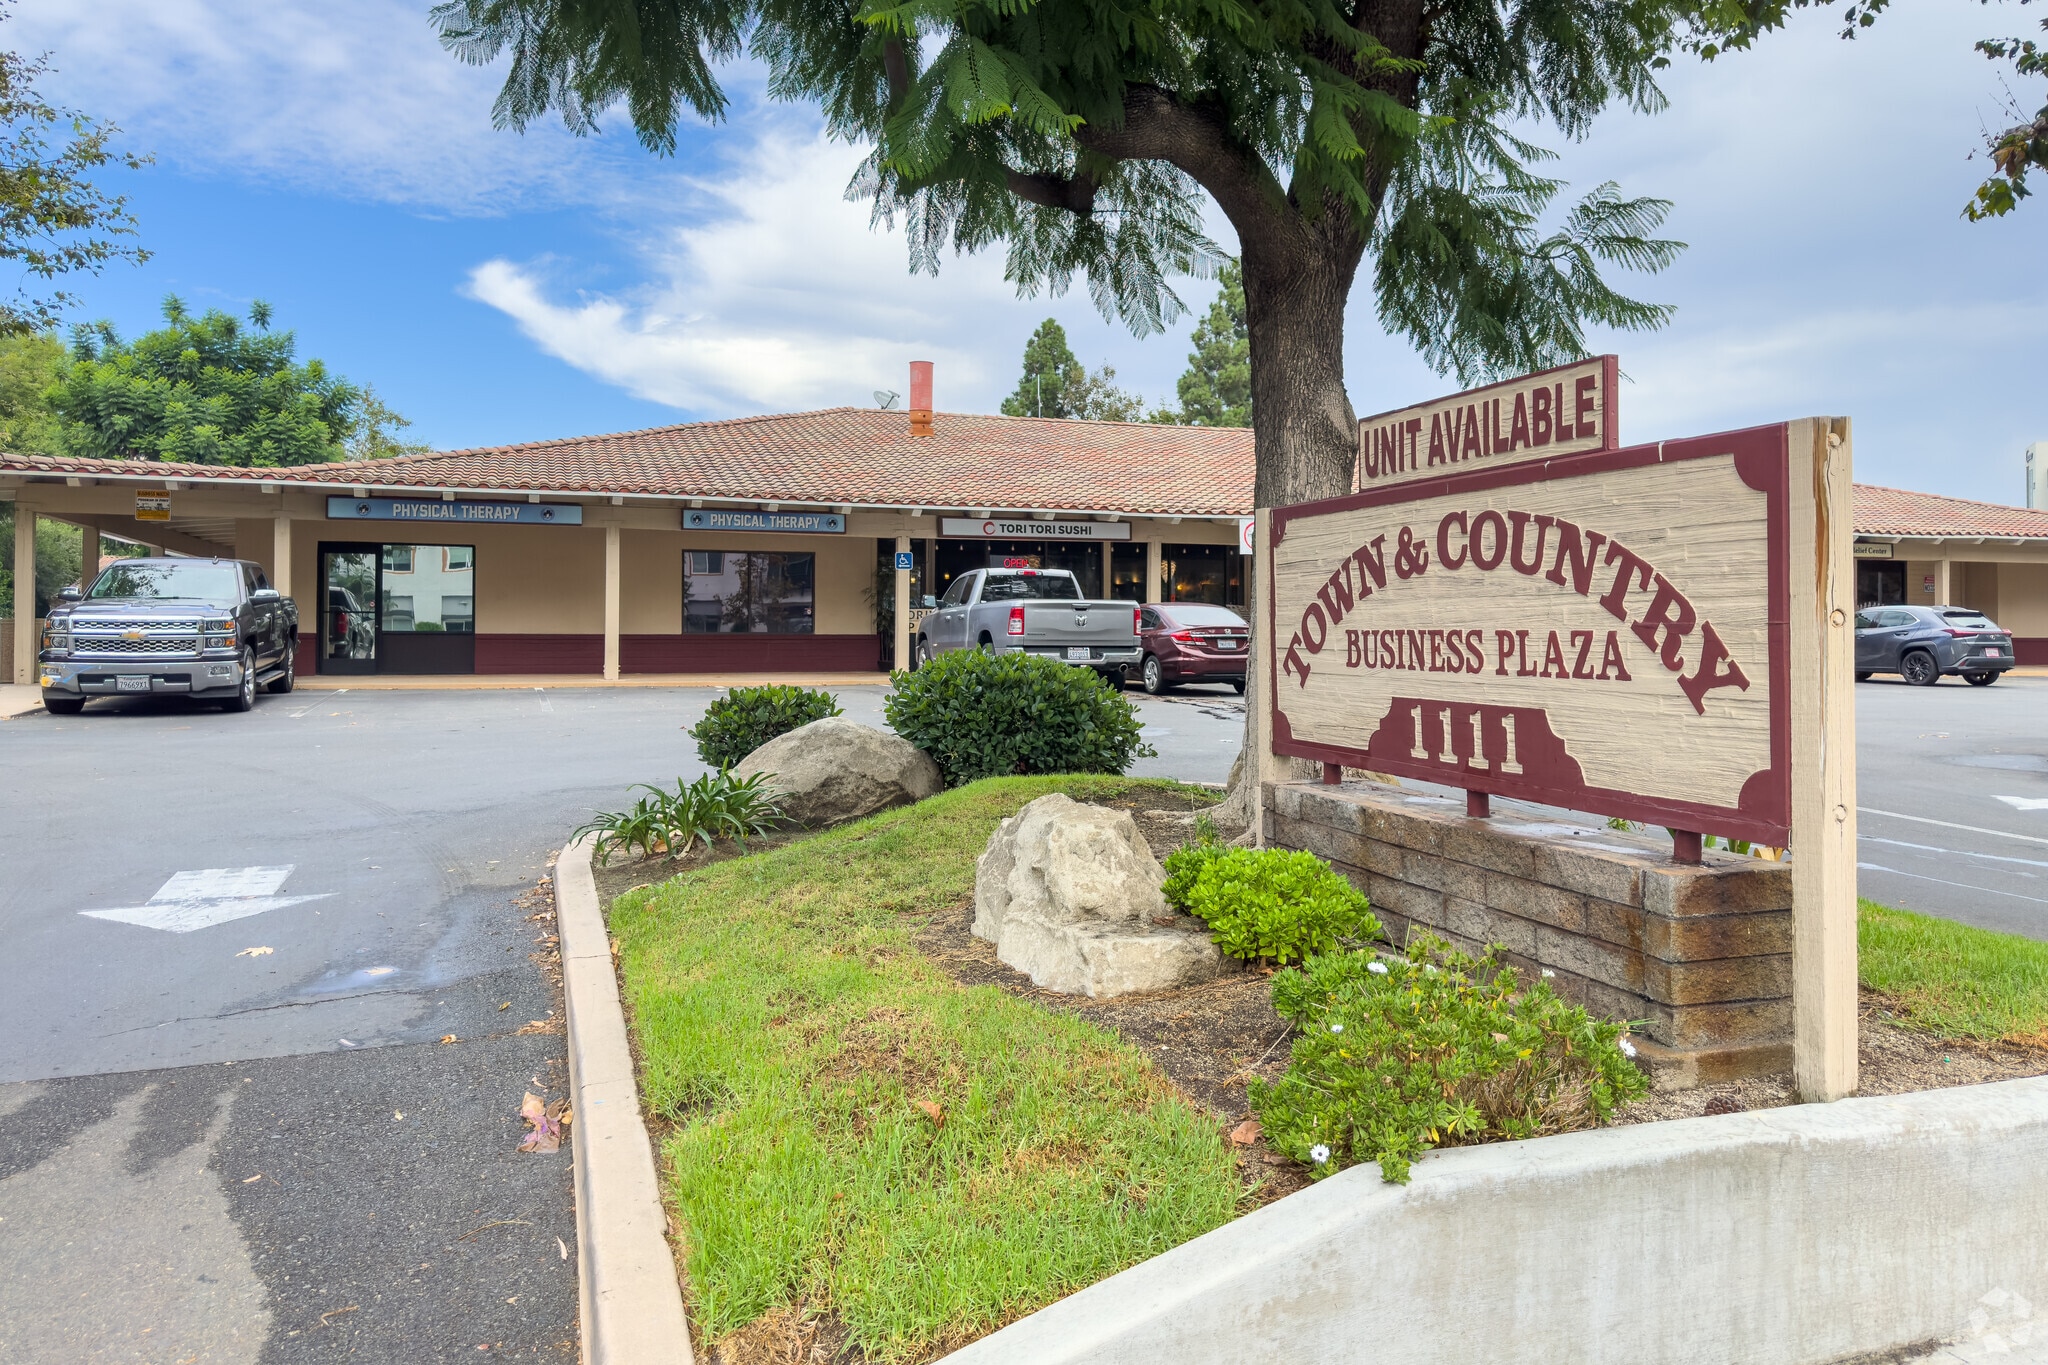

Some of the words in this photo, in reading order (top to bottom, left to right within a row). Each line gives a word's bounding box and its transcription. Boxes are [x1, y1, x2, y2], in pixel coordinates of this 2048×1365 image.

[1364, 419, 1422, 478] UNIT
[1427, 375, 1597, 466] AVAILABLE
[392, 503, 456, 518] PHYSICAL
[461, 505, 520, 520] THERAPY
[710, 513, 766, 528] PHYSICAL
[769, 516, 820, 529] THERAPY
[999, 523, 1027, 534] TORI
[1029, 524, 1056, 535] TORI
[1058, 525, 1092, 535] SUSHI
[1853, 546, 1868, 554] elief
[1868, 546, 1887, 555] Center
[1003, 558, 1029, 569] OPEN
[1283, 533, 1389, 689] TOWN
[1394, 526, 1430, 580] &
[1436, 510, 1750, 715] COUNTRY
[1346, 629, 1485, 675] BUSINESS
[1495, 629, 1632, 682] PLAZA
[1410, 705, 1524, 775] 1111
